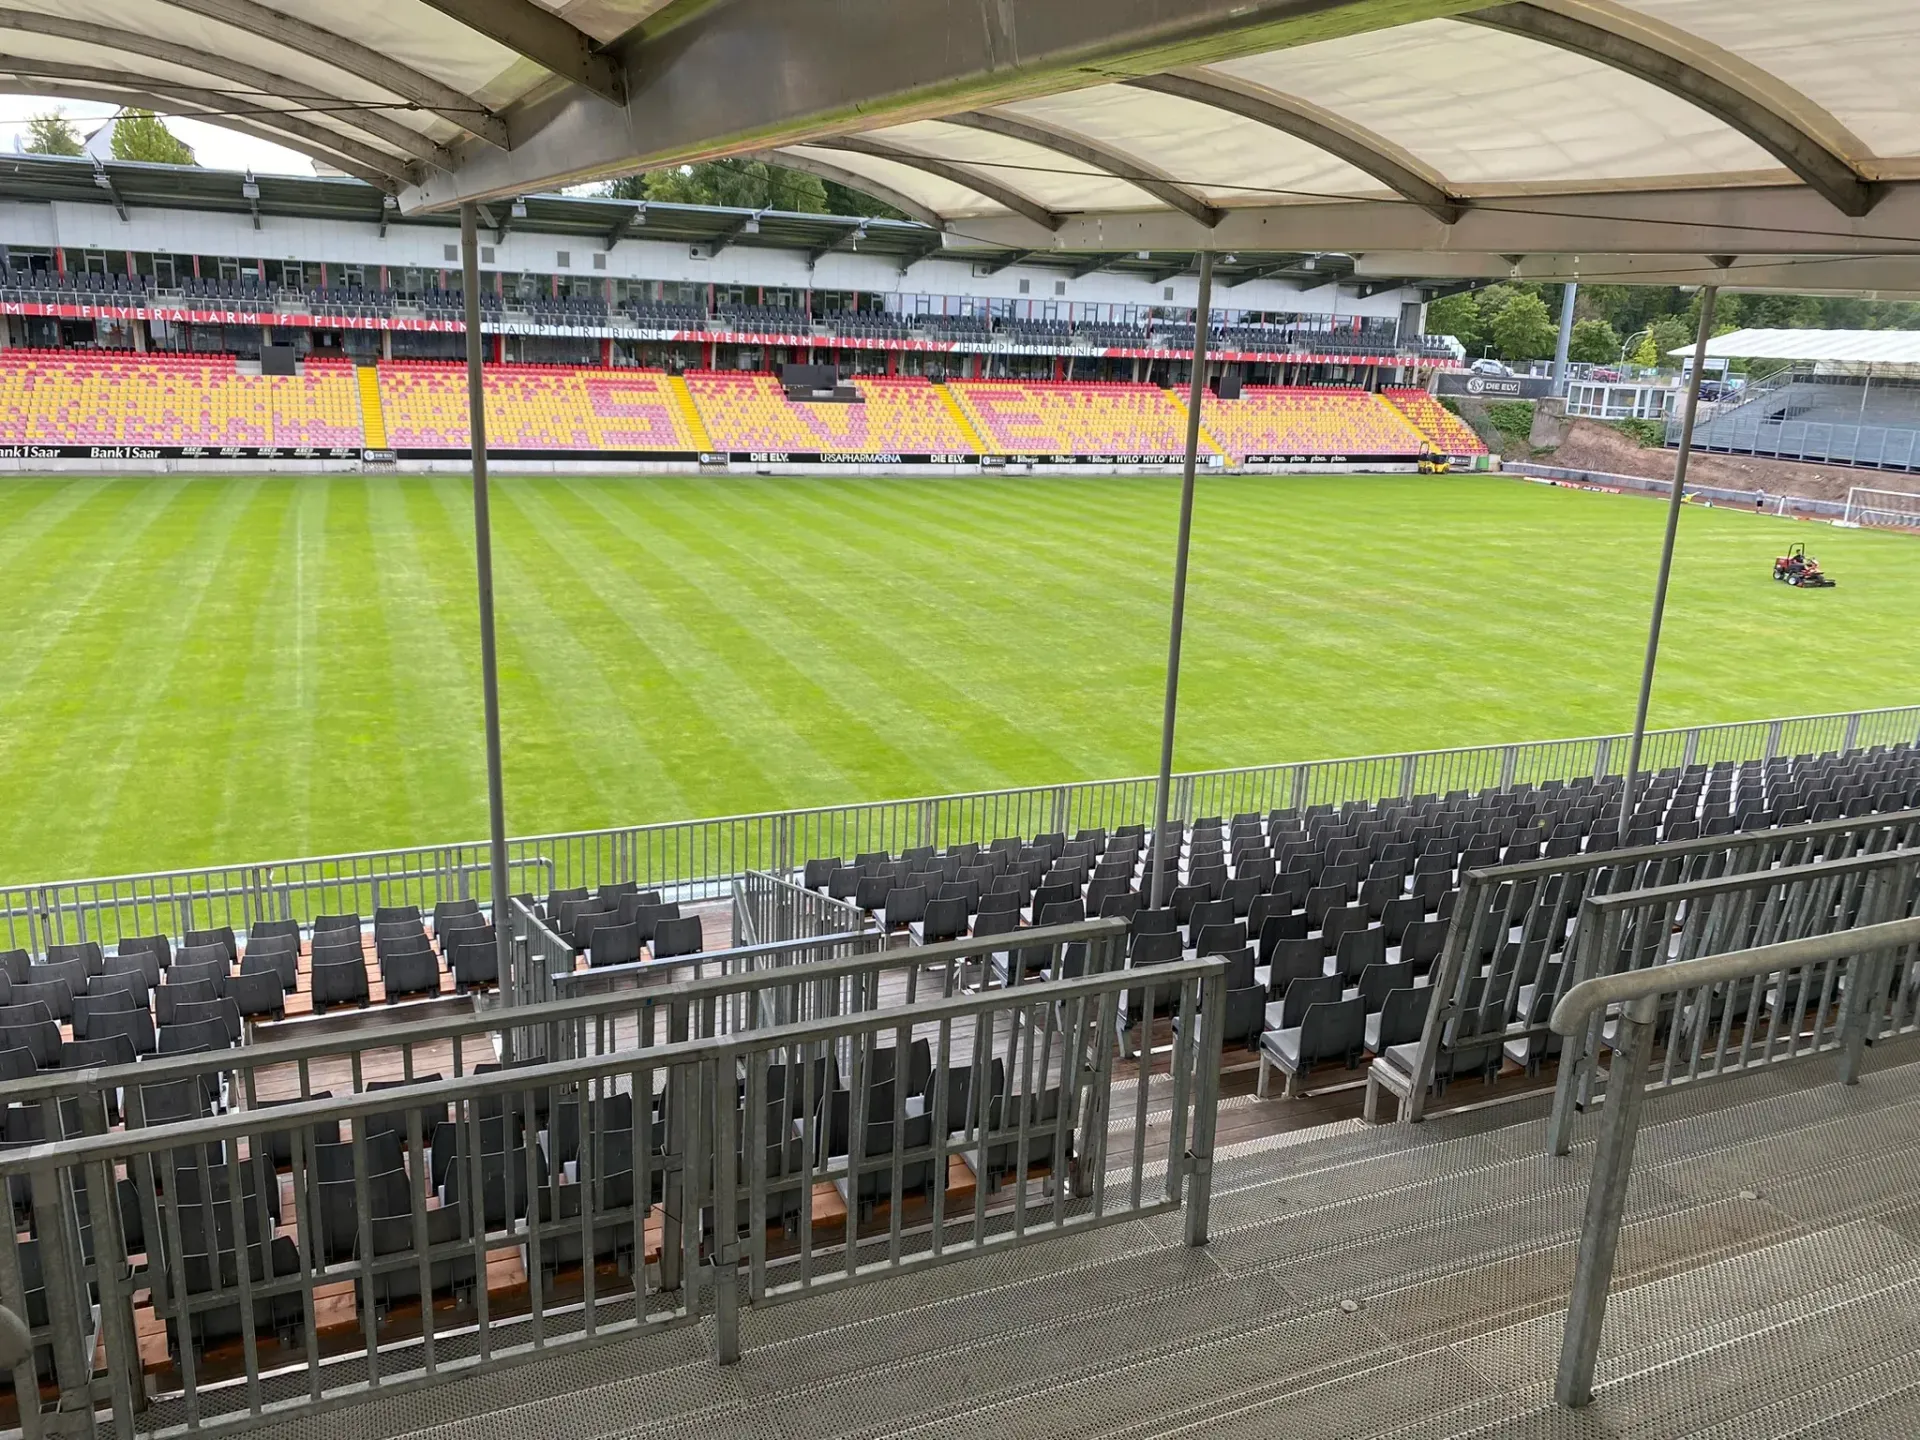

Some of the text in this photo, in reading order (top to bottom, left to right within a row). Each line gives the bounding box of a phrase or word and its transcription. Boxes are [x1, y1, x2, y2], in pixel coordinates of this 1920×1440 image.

[83, 306, 256, 325] FLYERALARM
[684, 331, 812, 346] FLYERALARM
[829, 337, 948, 351] FLYERALARM
[1122, 348, 1223, 360] FLYERALRM
[1256, 353, 1350, 363] FLYERALARM
[1378, 356, 1462, 367] FLYERALARM
[1486, 383, 1500, 391] DIE
[0, 446, 60, 457] ank1Saar
[90, 447, 161, 458] Bank1Saar
[750, 453, 768, 462] DIE
[820, 453, 901, 462] URSAPHARMARENA
[931, 455, 947, 463] DIE
[1169, 455, 1186, 463] HYL
